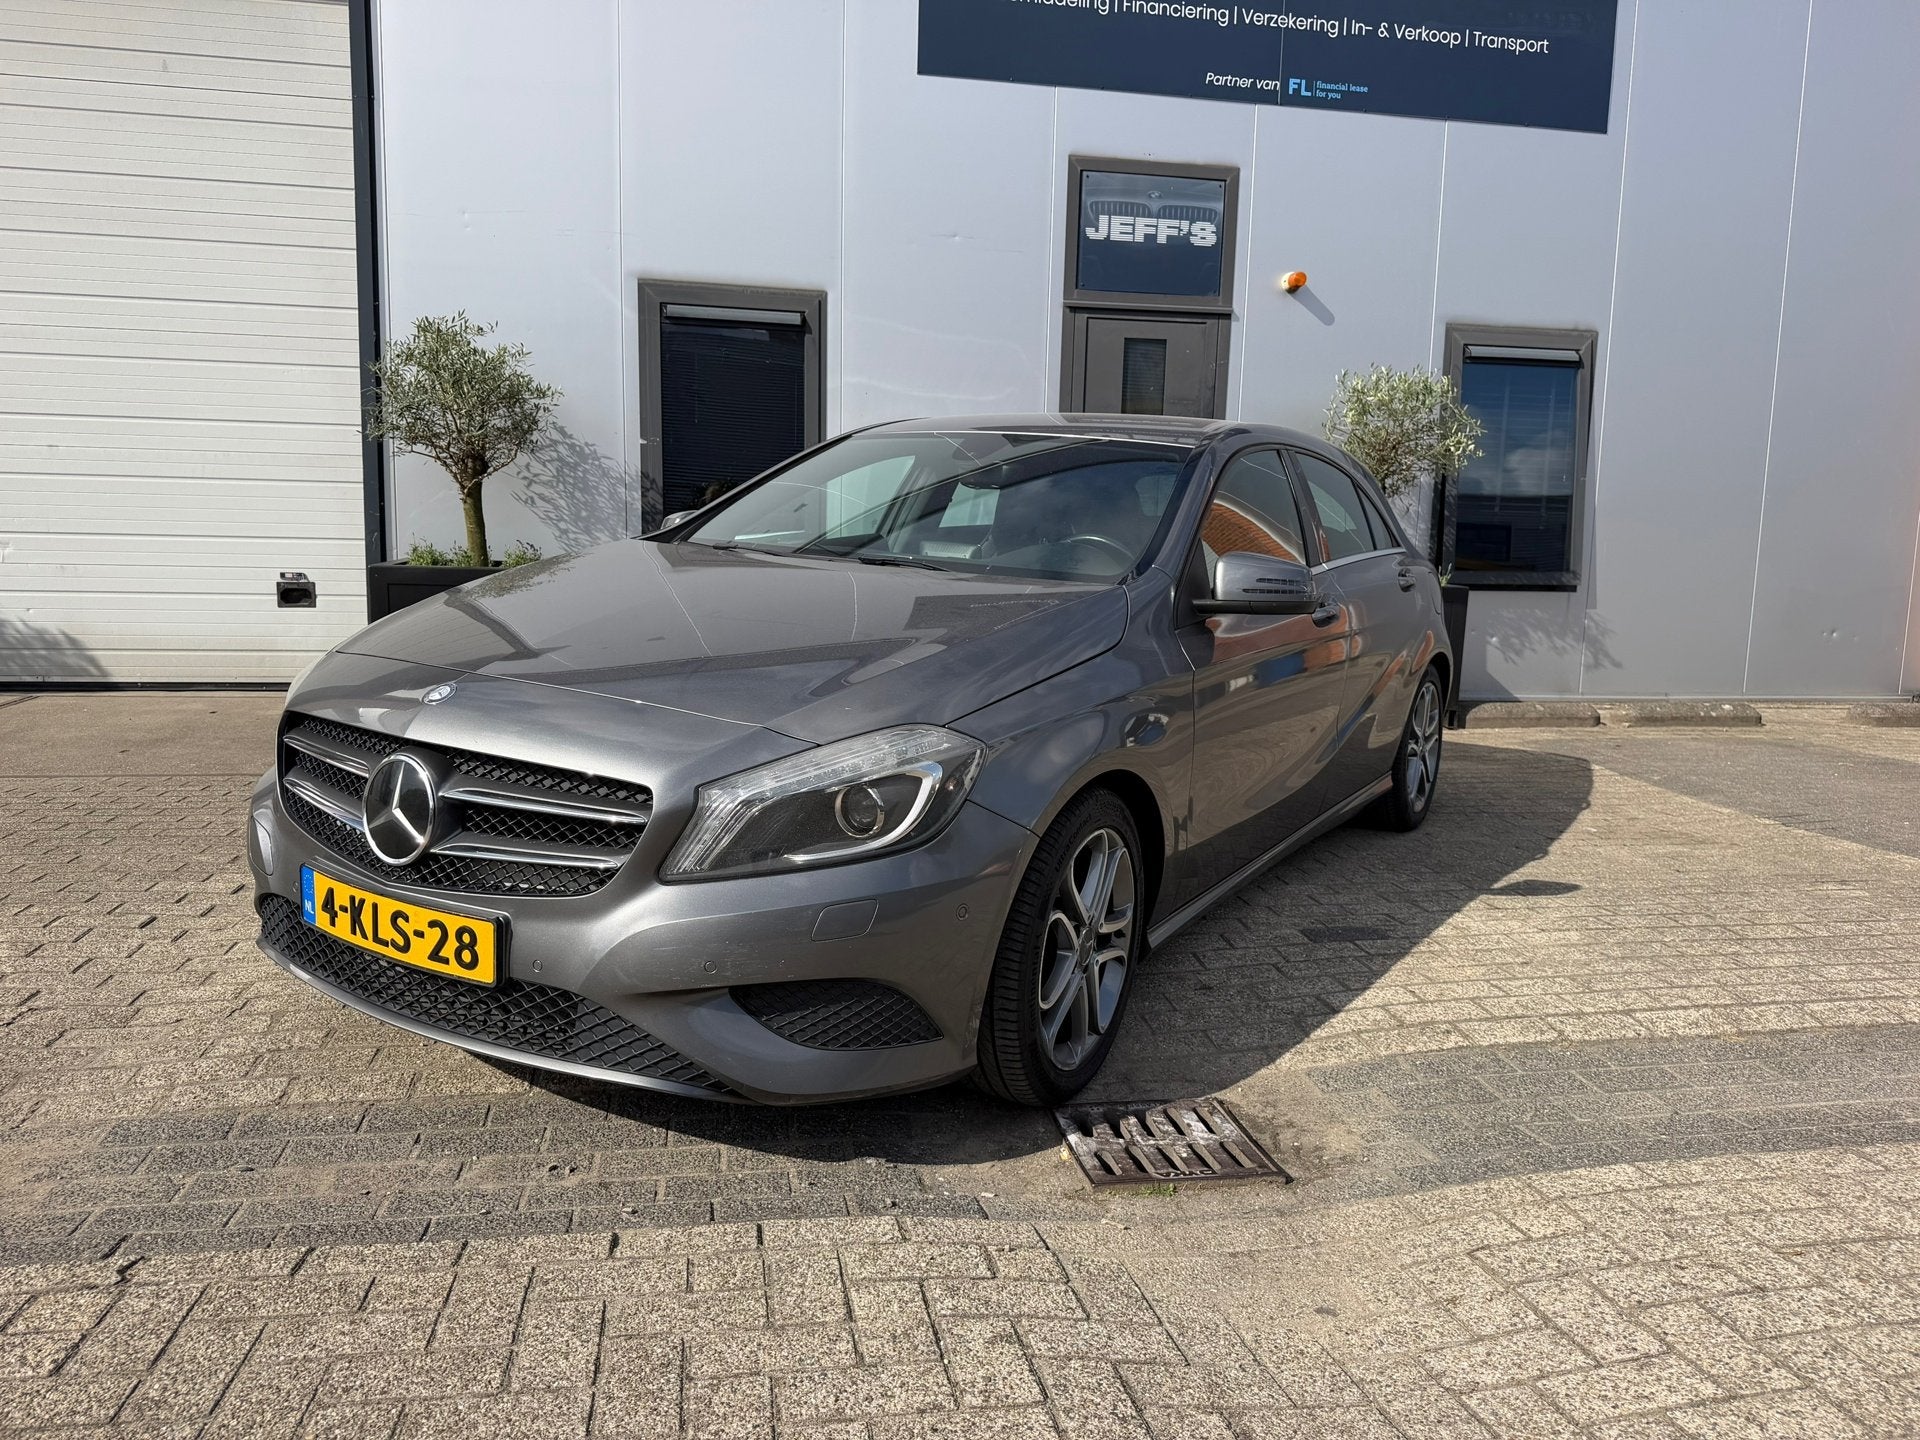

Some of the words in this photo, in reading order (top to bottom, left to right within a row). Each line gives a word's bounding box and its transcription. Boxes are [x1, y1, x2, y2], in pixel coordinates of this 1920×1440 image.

[1123, 0, 1229, 26] Financiering
[1242, 8, 1339, 38] Verzekering
[1352, 20, 1373, 36] In-
[1378, 23, 1390, 38] &
[1394, 24, 1462, 49] Verkoop
[1473, 32, 1550, 55] Transport
[1205, 72, 1254, 88] Partner
[1256, 79, 1280, 91] van
[1289, 78, 1312, 96] FL
[1316, 81, 1348, 91] financial
[1349, 84, 1369, 92] lease
[1085, 214, 1217, 247] JEFF'S
[305, 899, 314, 914] NL
[321, 887, 479, 970] 4-KLS-28
